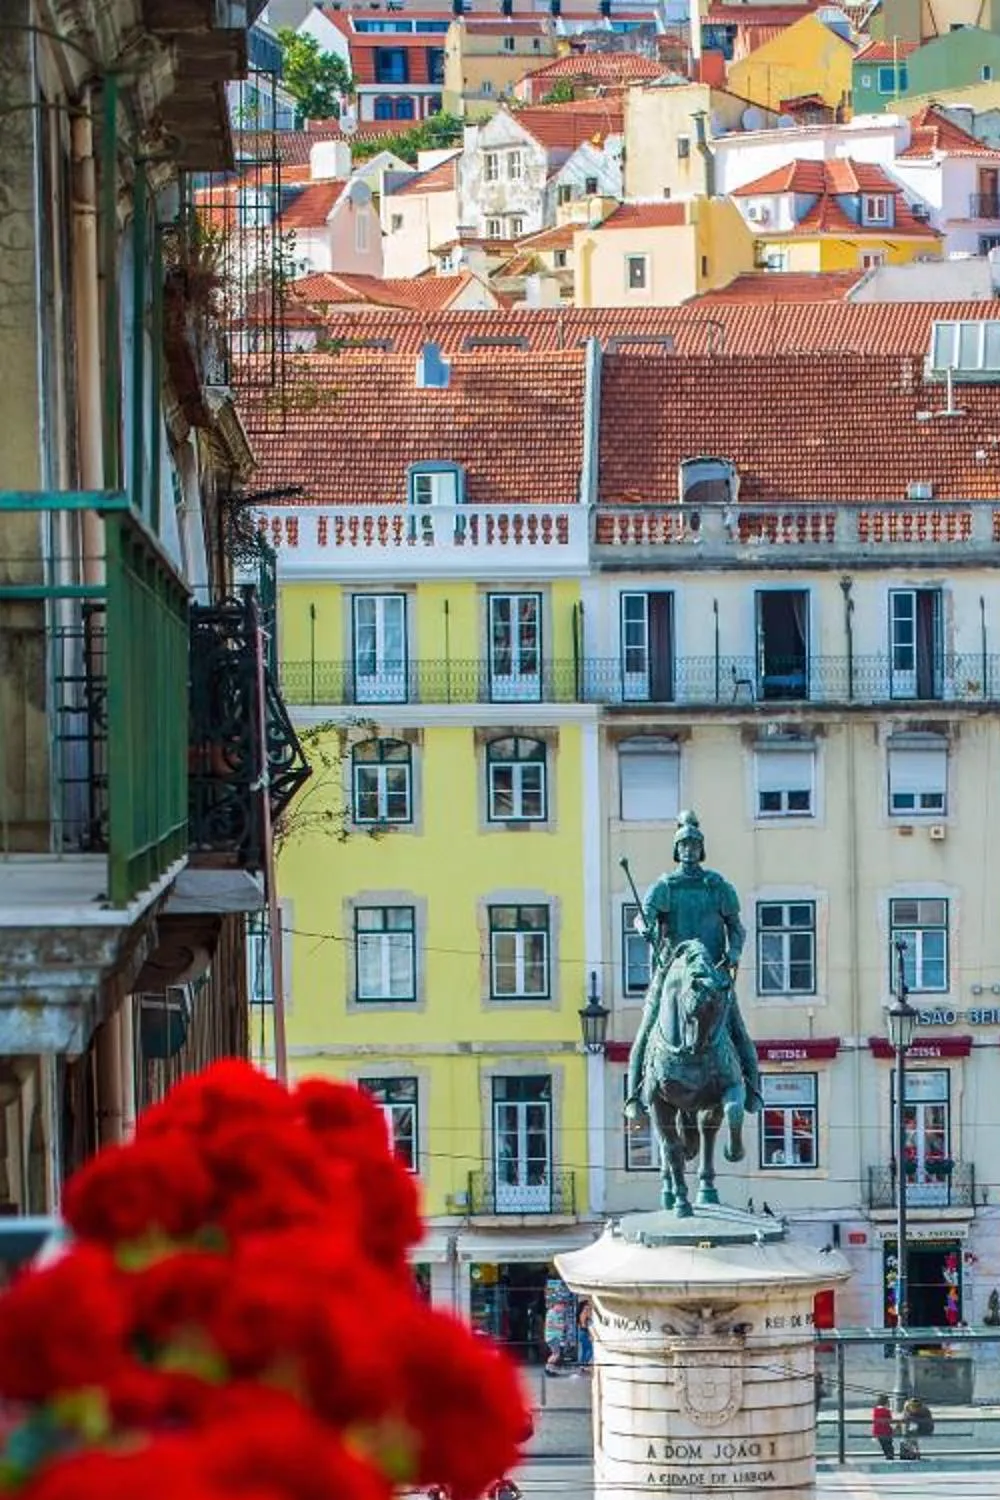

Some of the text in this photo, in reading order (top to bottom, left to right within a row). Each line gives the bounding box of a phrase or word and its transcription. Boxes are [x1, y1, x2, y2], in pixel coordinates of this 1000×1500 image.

[647, 1440, 777, 1459] A DOM JOÃO I
[659, 1472, 706, 1485] CIDADE
[711, 1474, 728, 1485] DE
[733, 1471, 776, 1484] LISBOA
